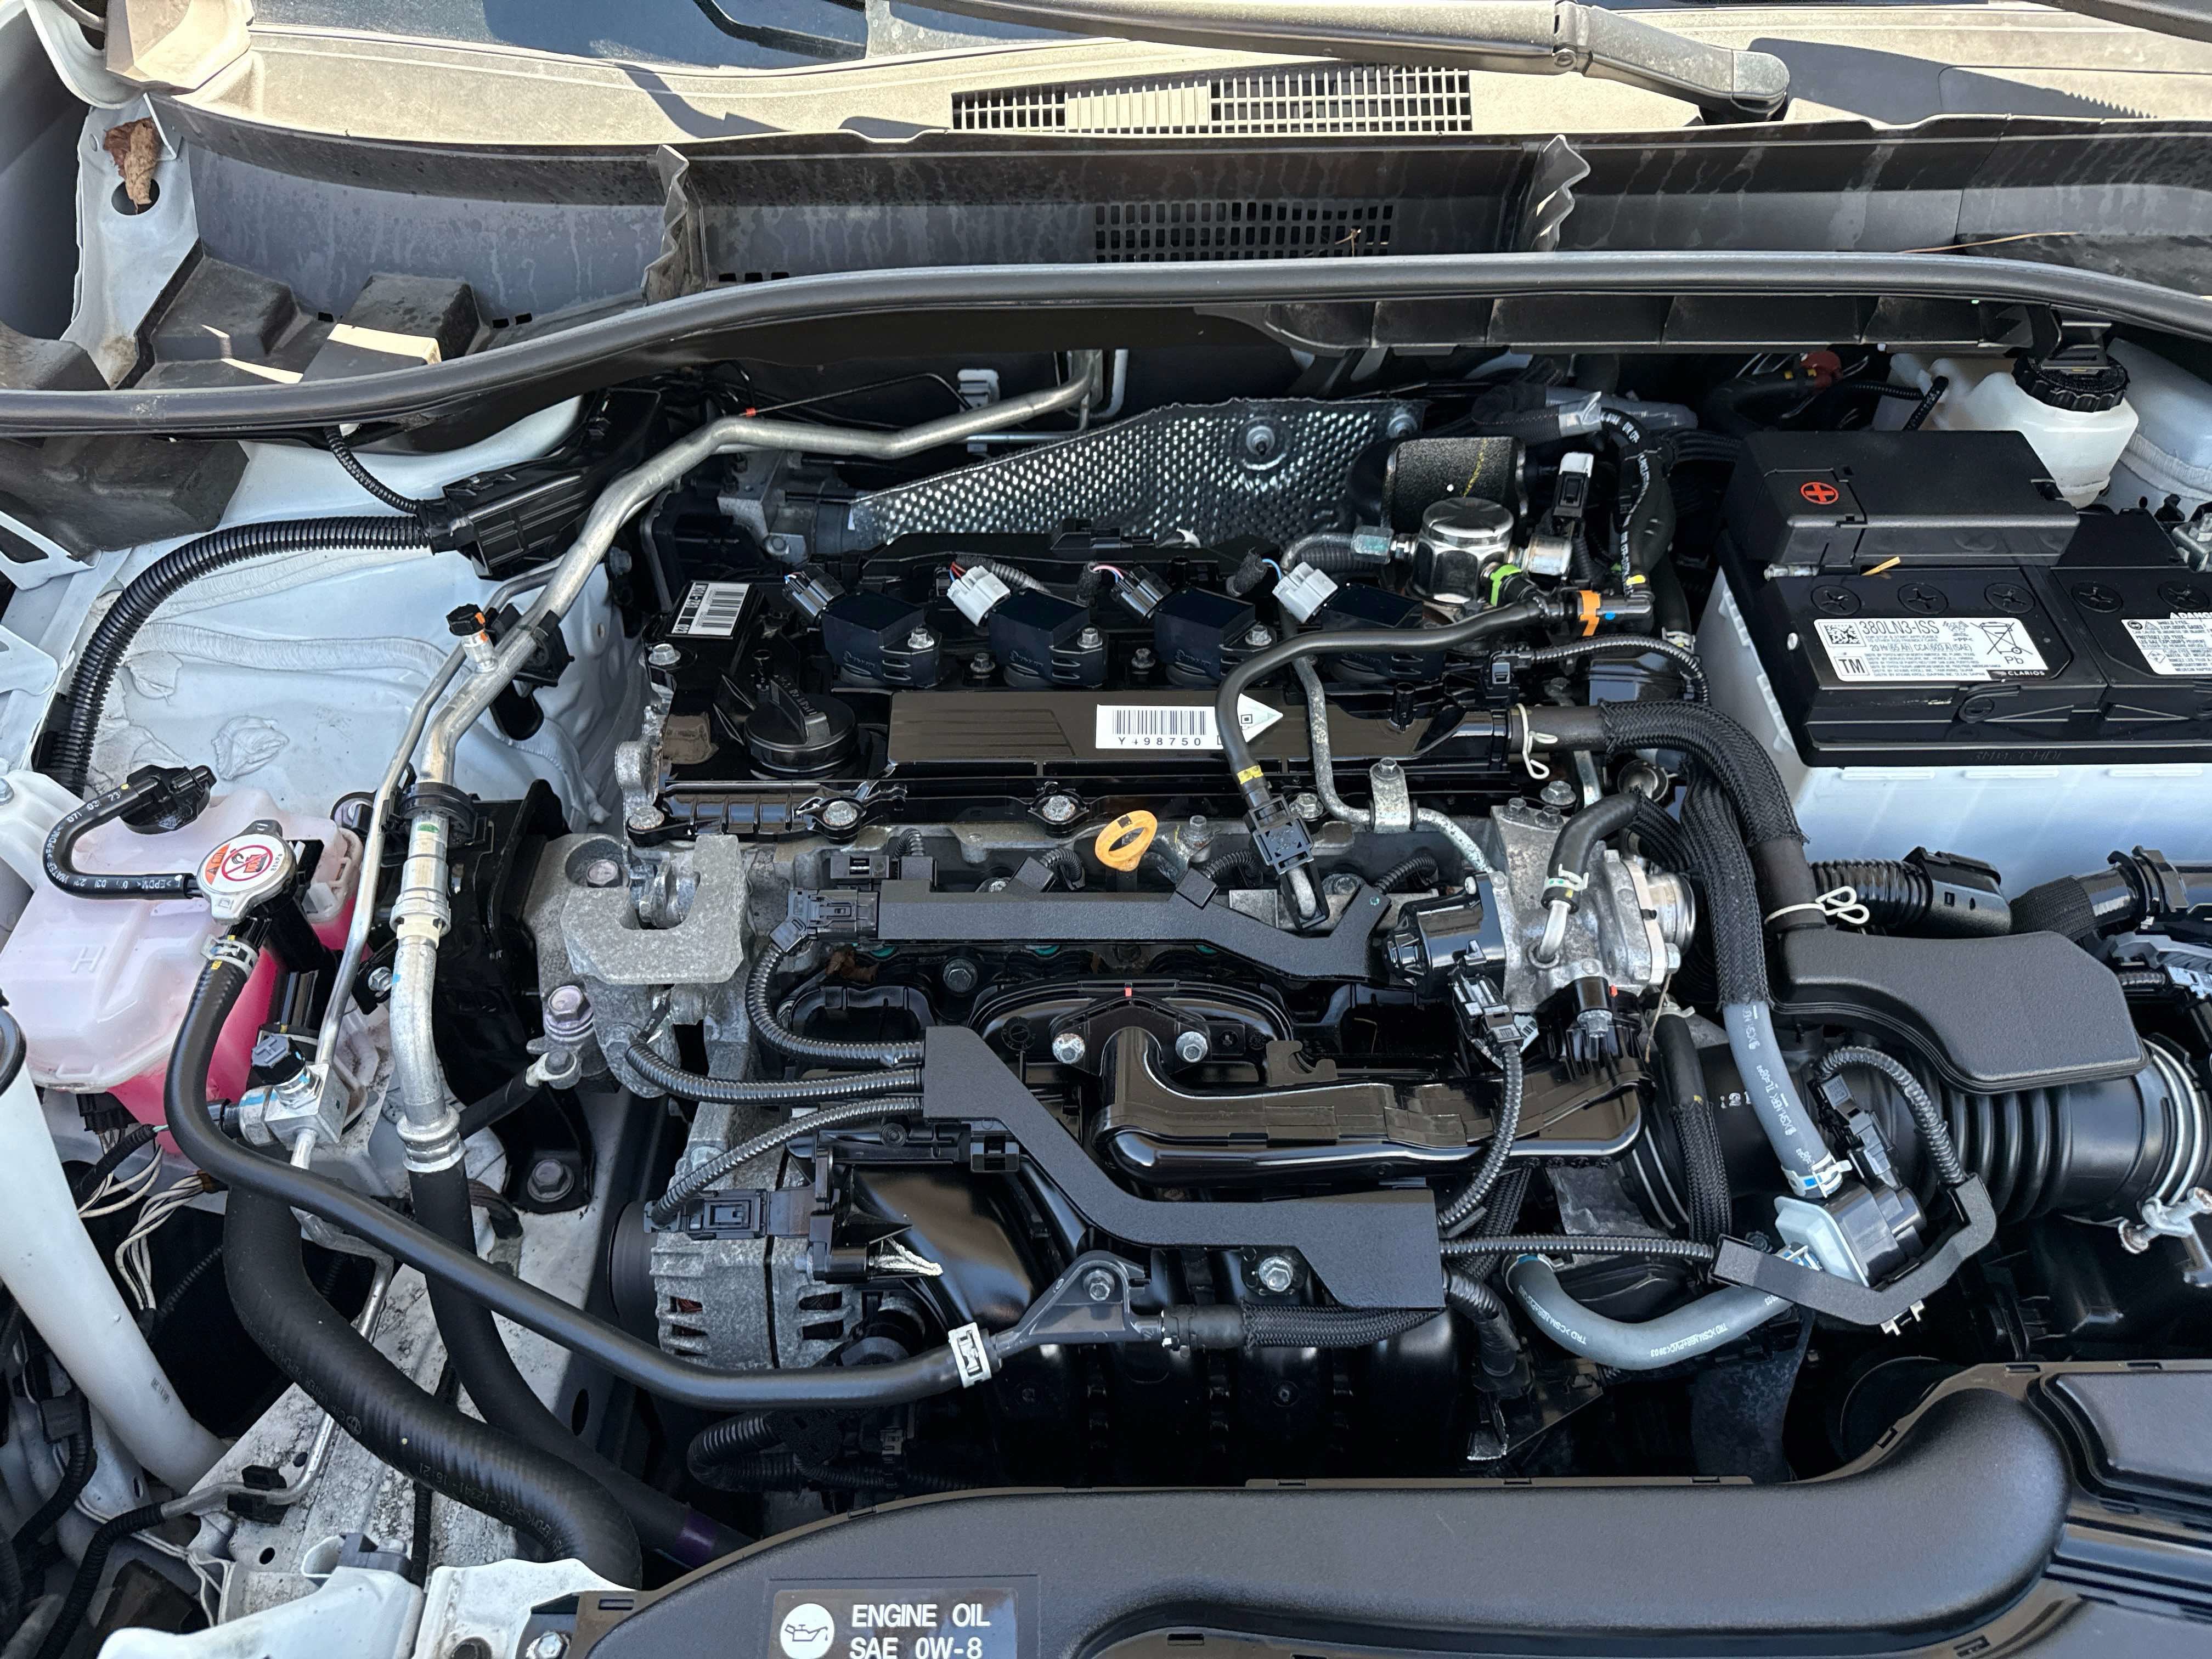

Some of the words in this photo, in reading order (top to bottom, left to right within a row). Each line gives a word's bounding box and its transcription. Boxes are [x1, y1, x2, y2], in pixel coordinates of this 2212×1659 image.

[1859, 620, 1940, 634] 380LN3-ISS
[1839, 658, 1865, 674] TM
[2004, 656, 2024, 664] Pb
[851, 1604, 937, 1628] ENGINE
[952, 1603, 991, 1627] OIL
[849, 1637, 898, 1659] SAE
[915, 1637, 982, 1659] 0W-8
